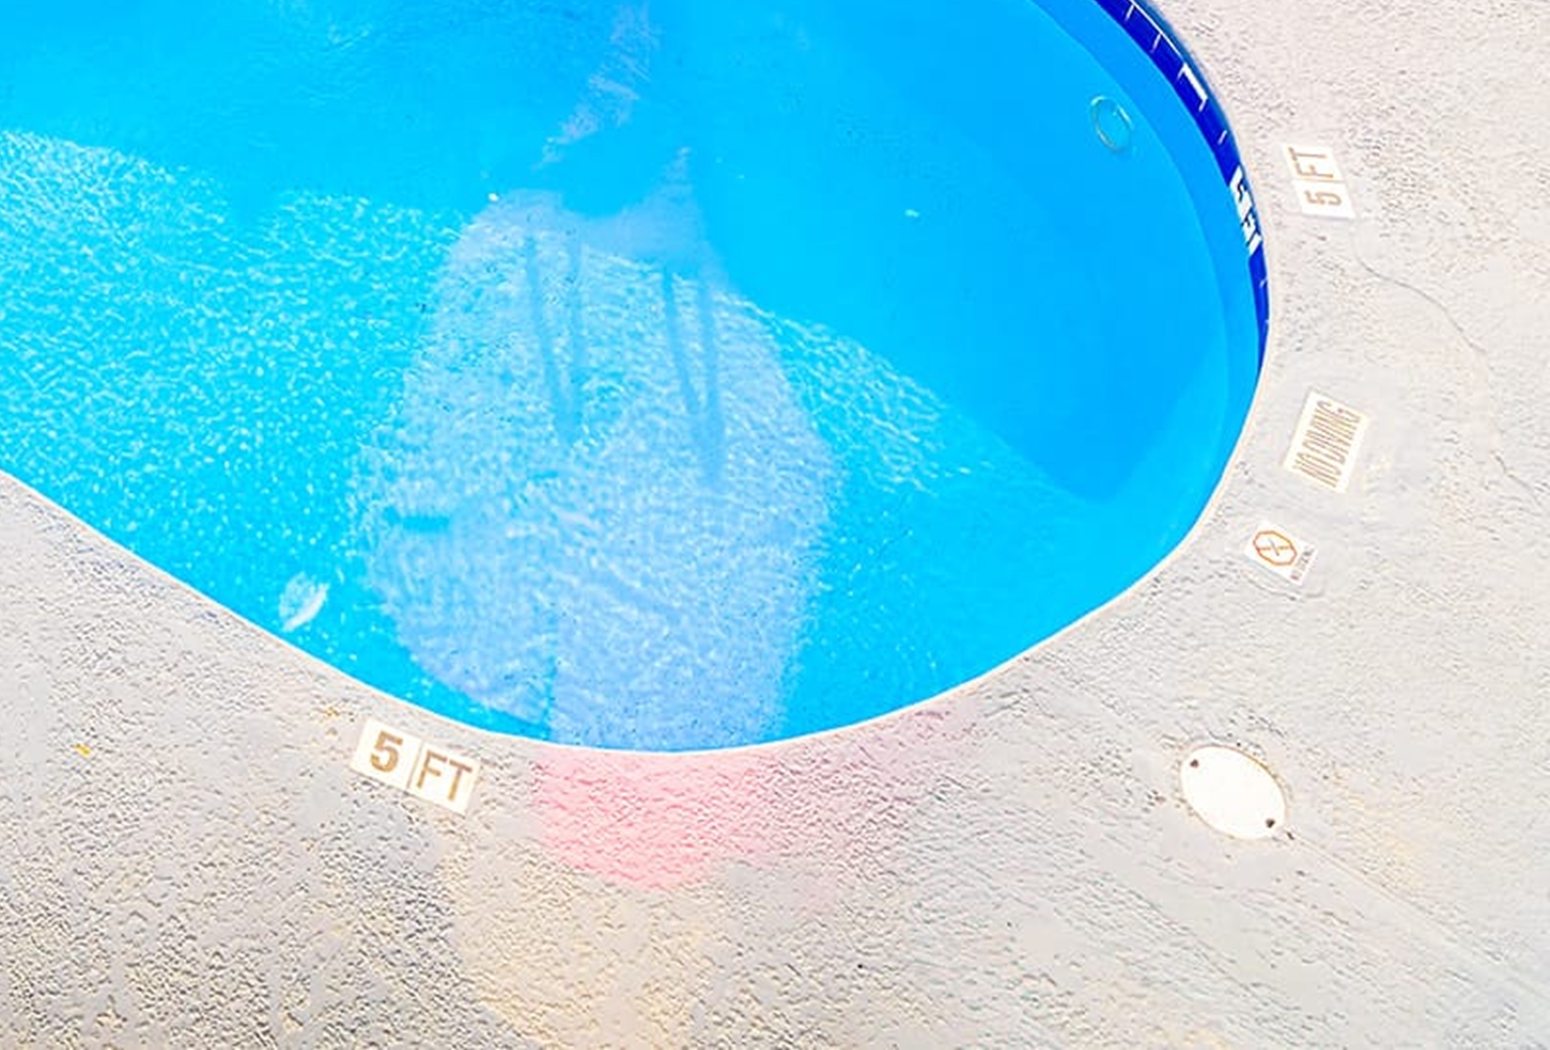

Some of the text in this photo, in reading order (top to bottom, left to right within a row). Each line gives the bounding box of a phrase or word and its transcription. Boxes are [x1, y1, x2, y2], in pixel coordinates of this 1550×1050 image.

[1288, 147, 1342, 206] 5 FT
[1302, 401, 1361, 465] DIVING
[1293, 452, 1342, 489] NO
[370, 730, 473, 802] 5 FT
